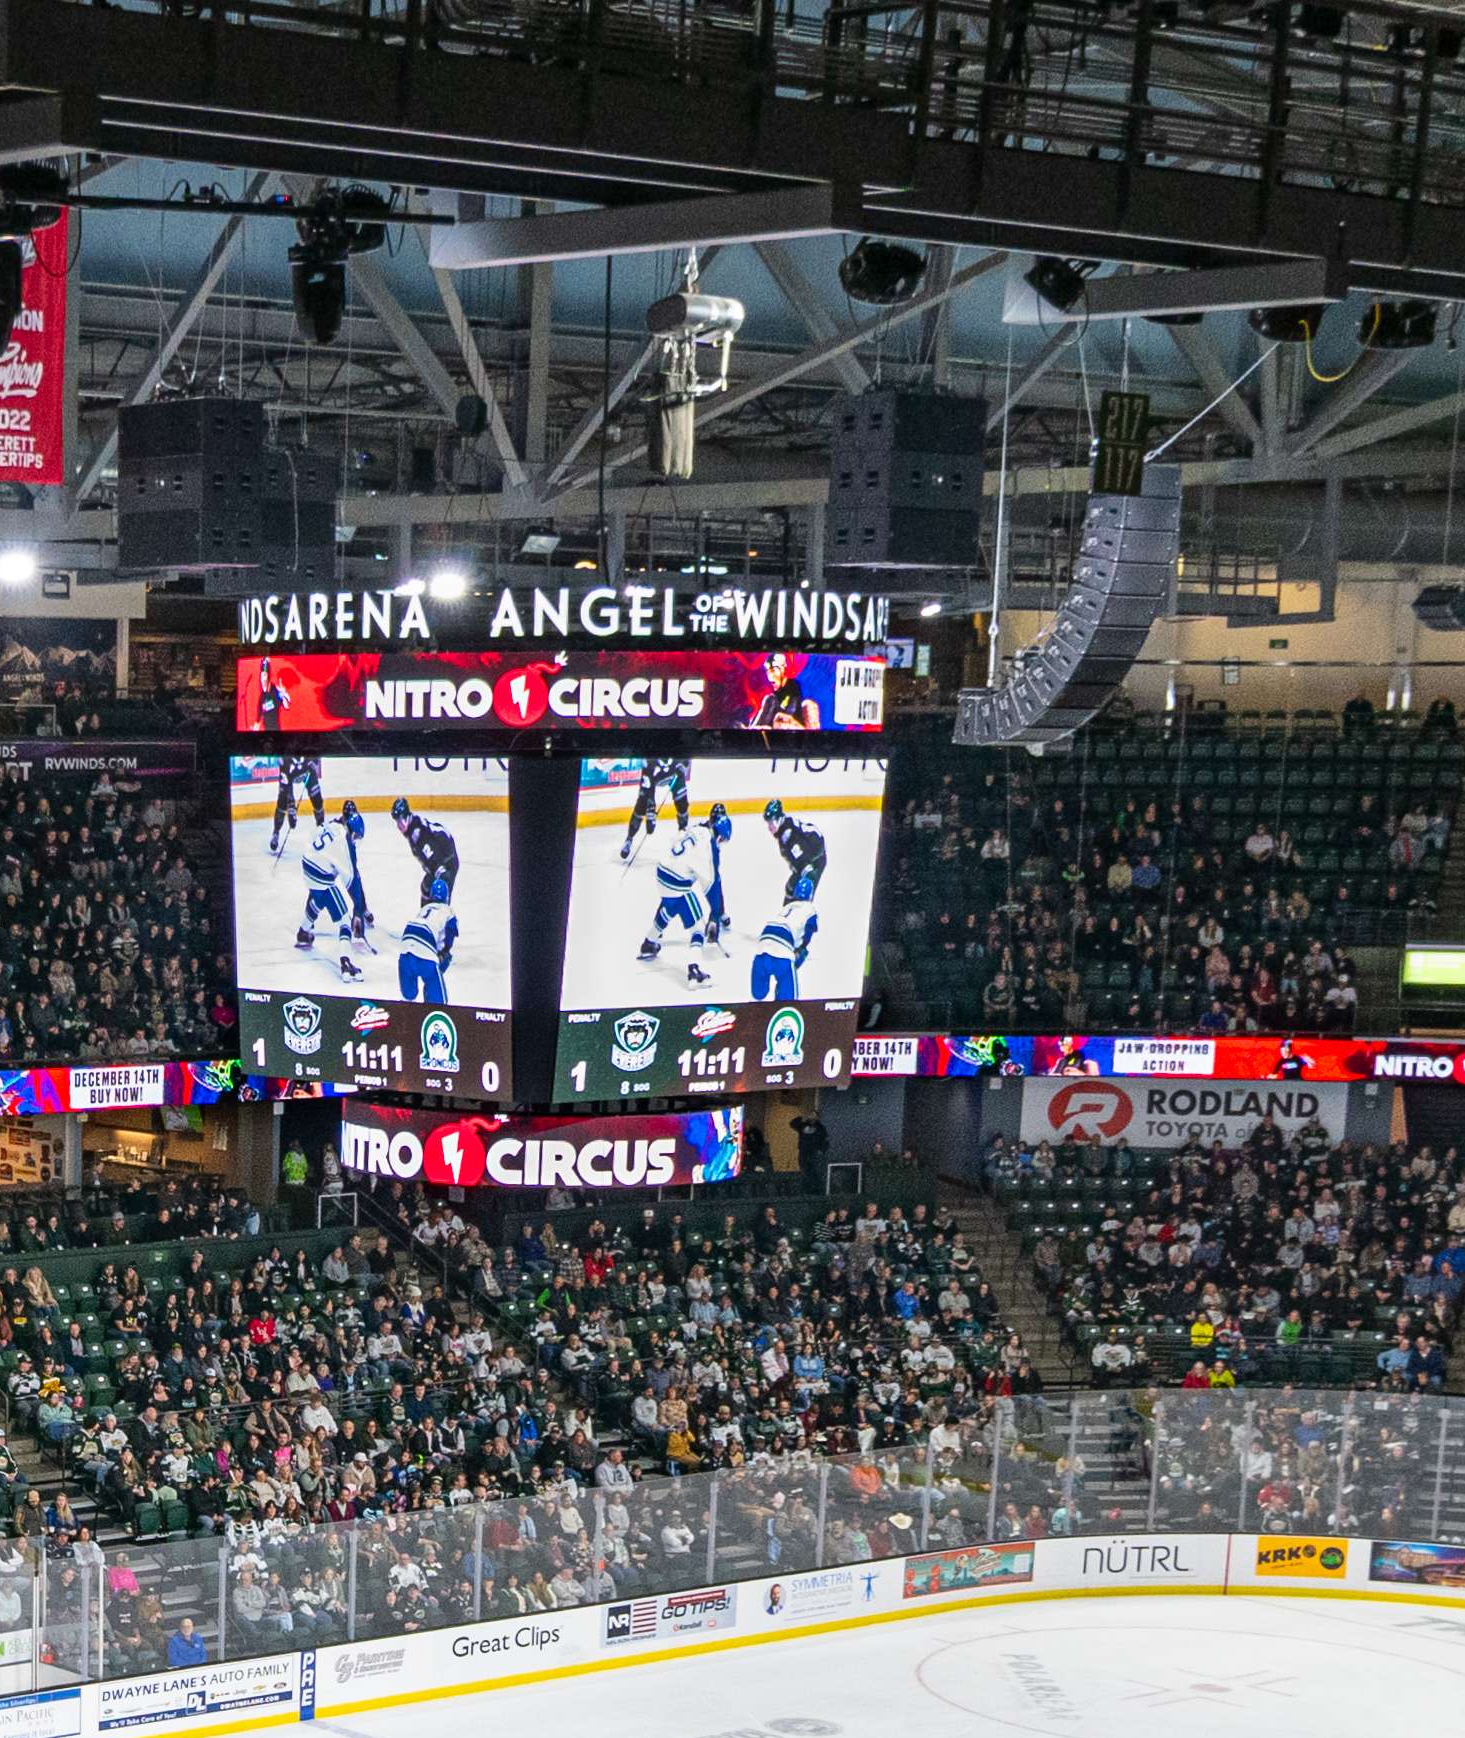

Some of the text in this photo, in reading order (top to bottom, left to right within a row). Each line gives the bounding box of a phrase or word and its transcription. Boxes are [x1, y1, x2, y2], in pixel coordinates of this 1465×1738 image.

[490, 586, 727, 638] ANGEL THE
[366, 678, 705, 718] NITRO CIRCUS
[475, 1012, 506, 1023] PENALTY
[568, 1013, 601, 1024] PENALTY
[252, 1038, 266, 1066] 1
[342, 1040, 403, 1072] 11:11
[677, 1047, 746, 1077] 11:11
[884, 1041, 913, 1056] 14TH
[481, 1061, 499, 1092] 0
[571, 1061, 588, 1092] 1
[785, 1070, 794, 1084] 3
[823, 1049, 842, 1078] 0
[863, 1057, 894, 1072] NOW!
[1142, 1060, 1185, 1073] ACTION
[1375, 1055, 1454, 1079] NITRO
[73, 1069, 160, 1088] DECEMBER 14TH
[445, 1078, 453, 1092] 3
[88, 1085, 143, 1103] BUY NOW!
[1146, 1089, 1320, 1118] RODLAND
[1146, 1122, 1227, 1140] TOYOTA
[486, 1137, 676, 1186] CIRCUS
[1083, 1540, 1190, 1575] NÜTRL
[662, 1597, 731, 1620] GO TIPS!
[452, 1625, 561, 1658] Great Clips
[102, 1662, 290, 1702] DWAYNE LANE'S AUTO FAMILY
